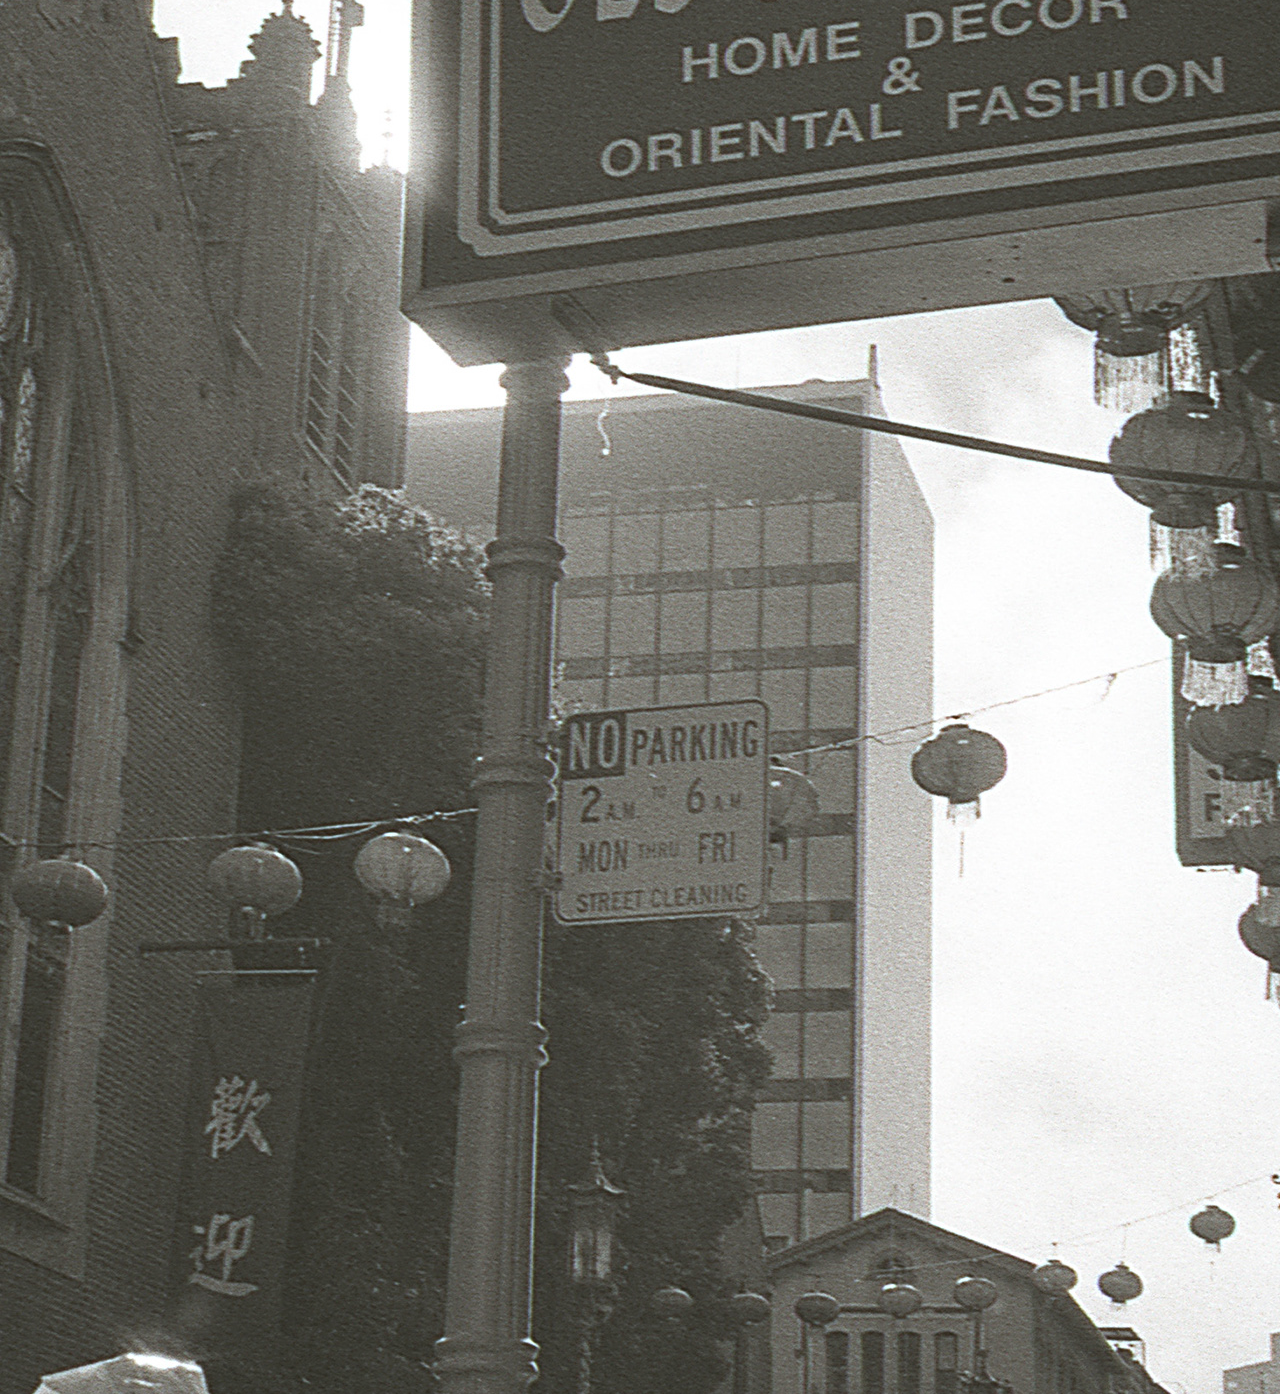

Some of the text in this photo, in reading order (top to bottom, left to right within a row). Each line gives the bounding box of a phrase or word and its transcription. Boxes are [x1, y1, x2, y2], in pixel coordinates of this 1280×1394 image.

[681, 21, 862, 84] HOME
[881, 57, 921, 95] &
[600, 56, 1226, 178] ORIENTAL FASHION
[570, 718, 759, 772] NO PARKING
[578, 831, 736, 873] MON THRU FRI
[576, 882, 748, 913] STREET CLEANING
[188, 1076, 272, 1296] 歡迎
